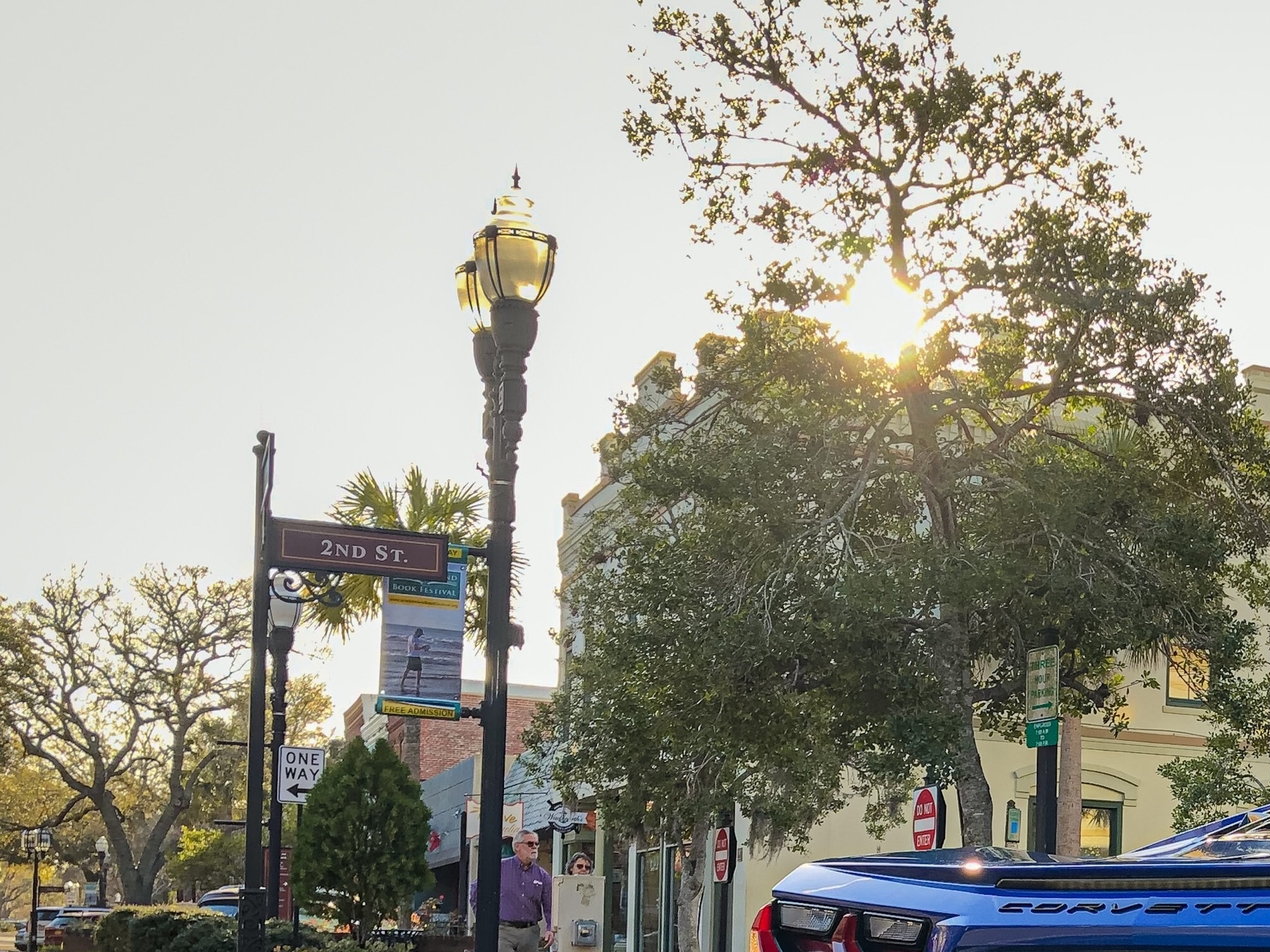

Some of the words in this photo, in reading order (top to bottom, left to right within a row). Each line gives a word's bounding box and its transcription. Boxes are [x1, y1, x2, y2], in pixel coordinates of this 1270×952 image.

[321, 539, 366, 559] 2ND
[392, 583, 417, 592] BOOK
[419, 585, 456, 597] FESTIVAL
[384, 705, 406, 714] FREE
[407, 707, 454, 717] ADMISSION
[286, 751, 320, 766] ONE
[285, 766, 320, 781] WAY
[916, 803, 923, 817] DO
[923, 802, 933, 815] NOT
